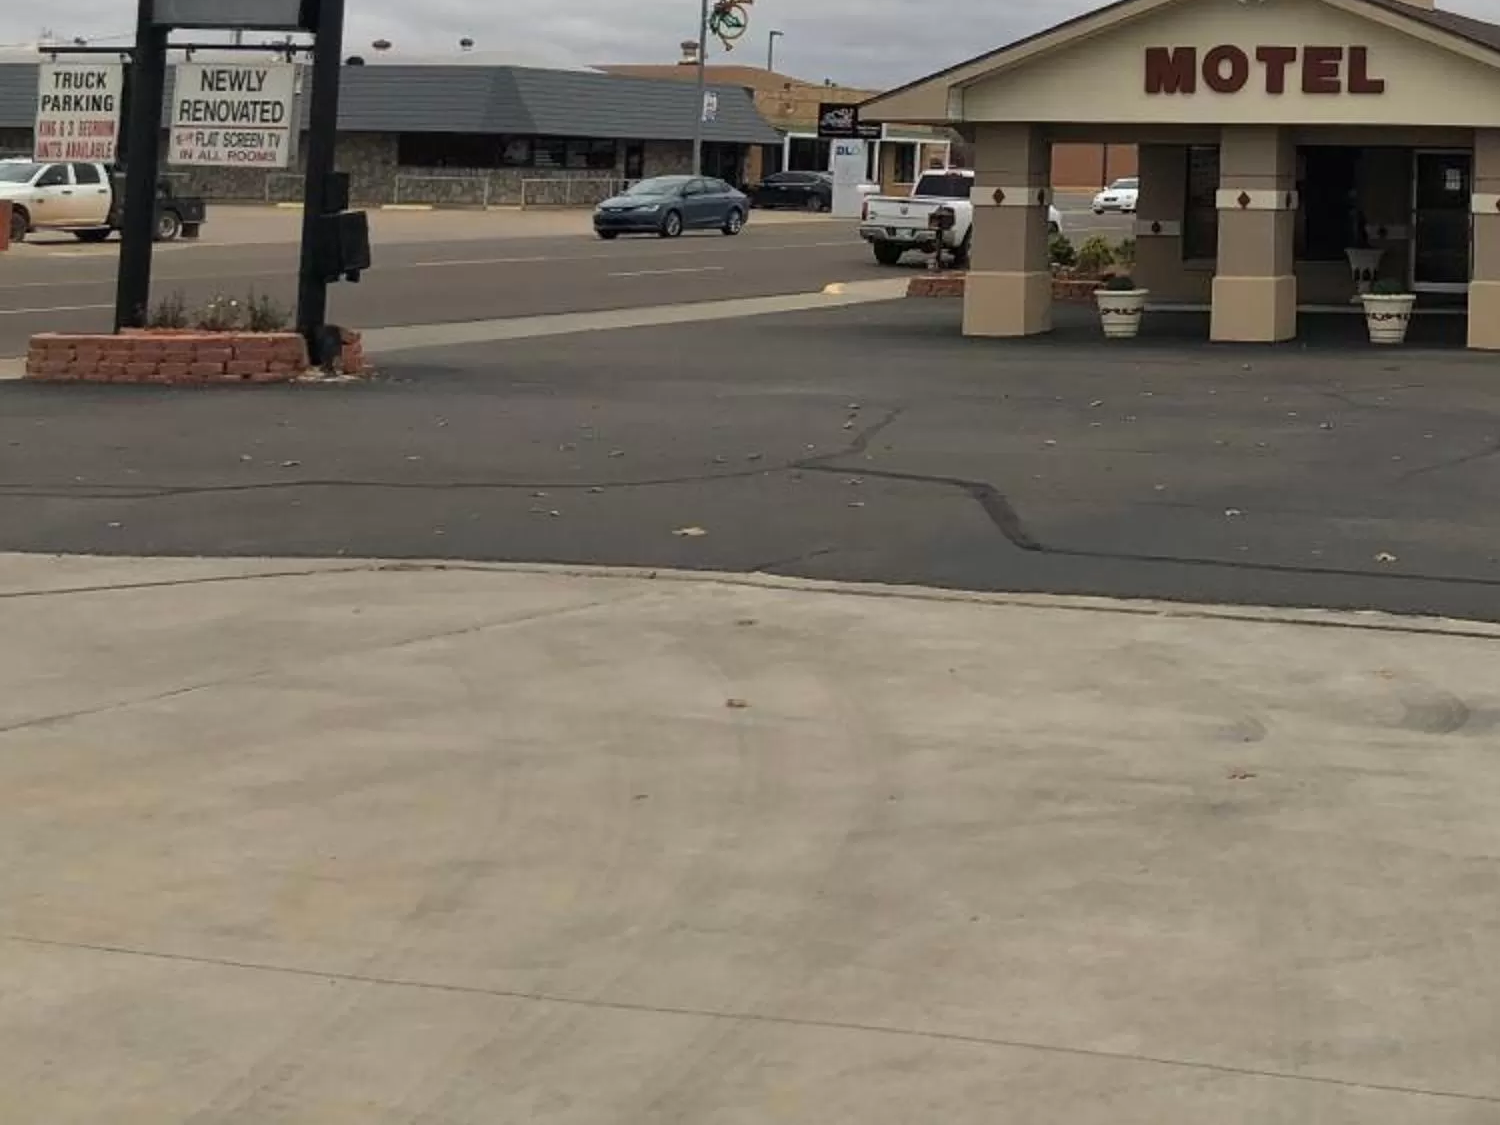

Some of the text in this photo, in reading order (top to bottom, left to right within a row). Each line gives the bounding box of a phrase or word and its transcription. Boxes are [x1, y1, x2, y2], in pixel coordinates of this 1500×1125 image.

[1144, 44, 1385, 94] MOTEL
[53, 71, 107, 90] TRUCK
[201, 69, 267, 92] NEWLY
[41, 94, 114, 113] PARKING
[179, 100, 285, 123] RENOVATED
[195, 131, 220, 148] FLAT
[223, 131, 265, 148] SCREEN
[268, 132, 281, 149] TV
[179, 150, 277, 162] IN ALL ROOMS
